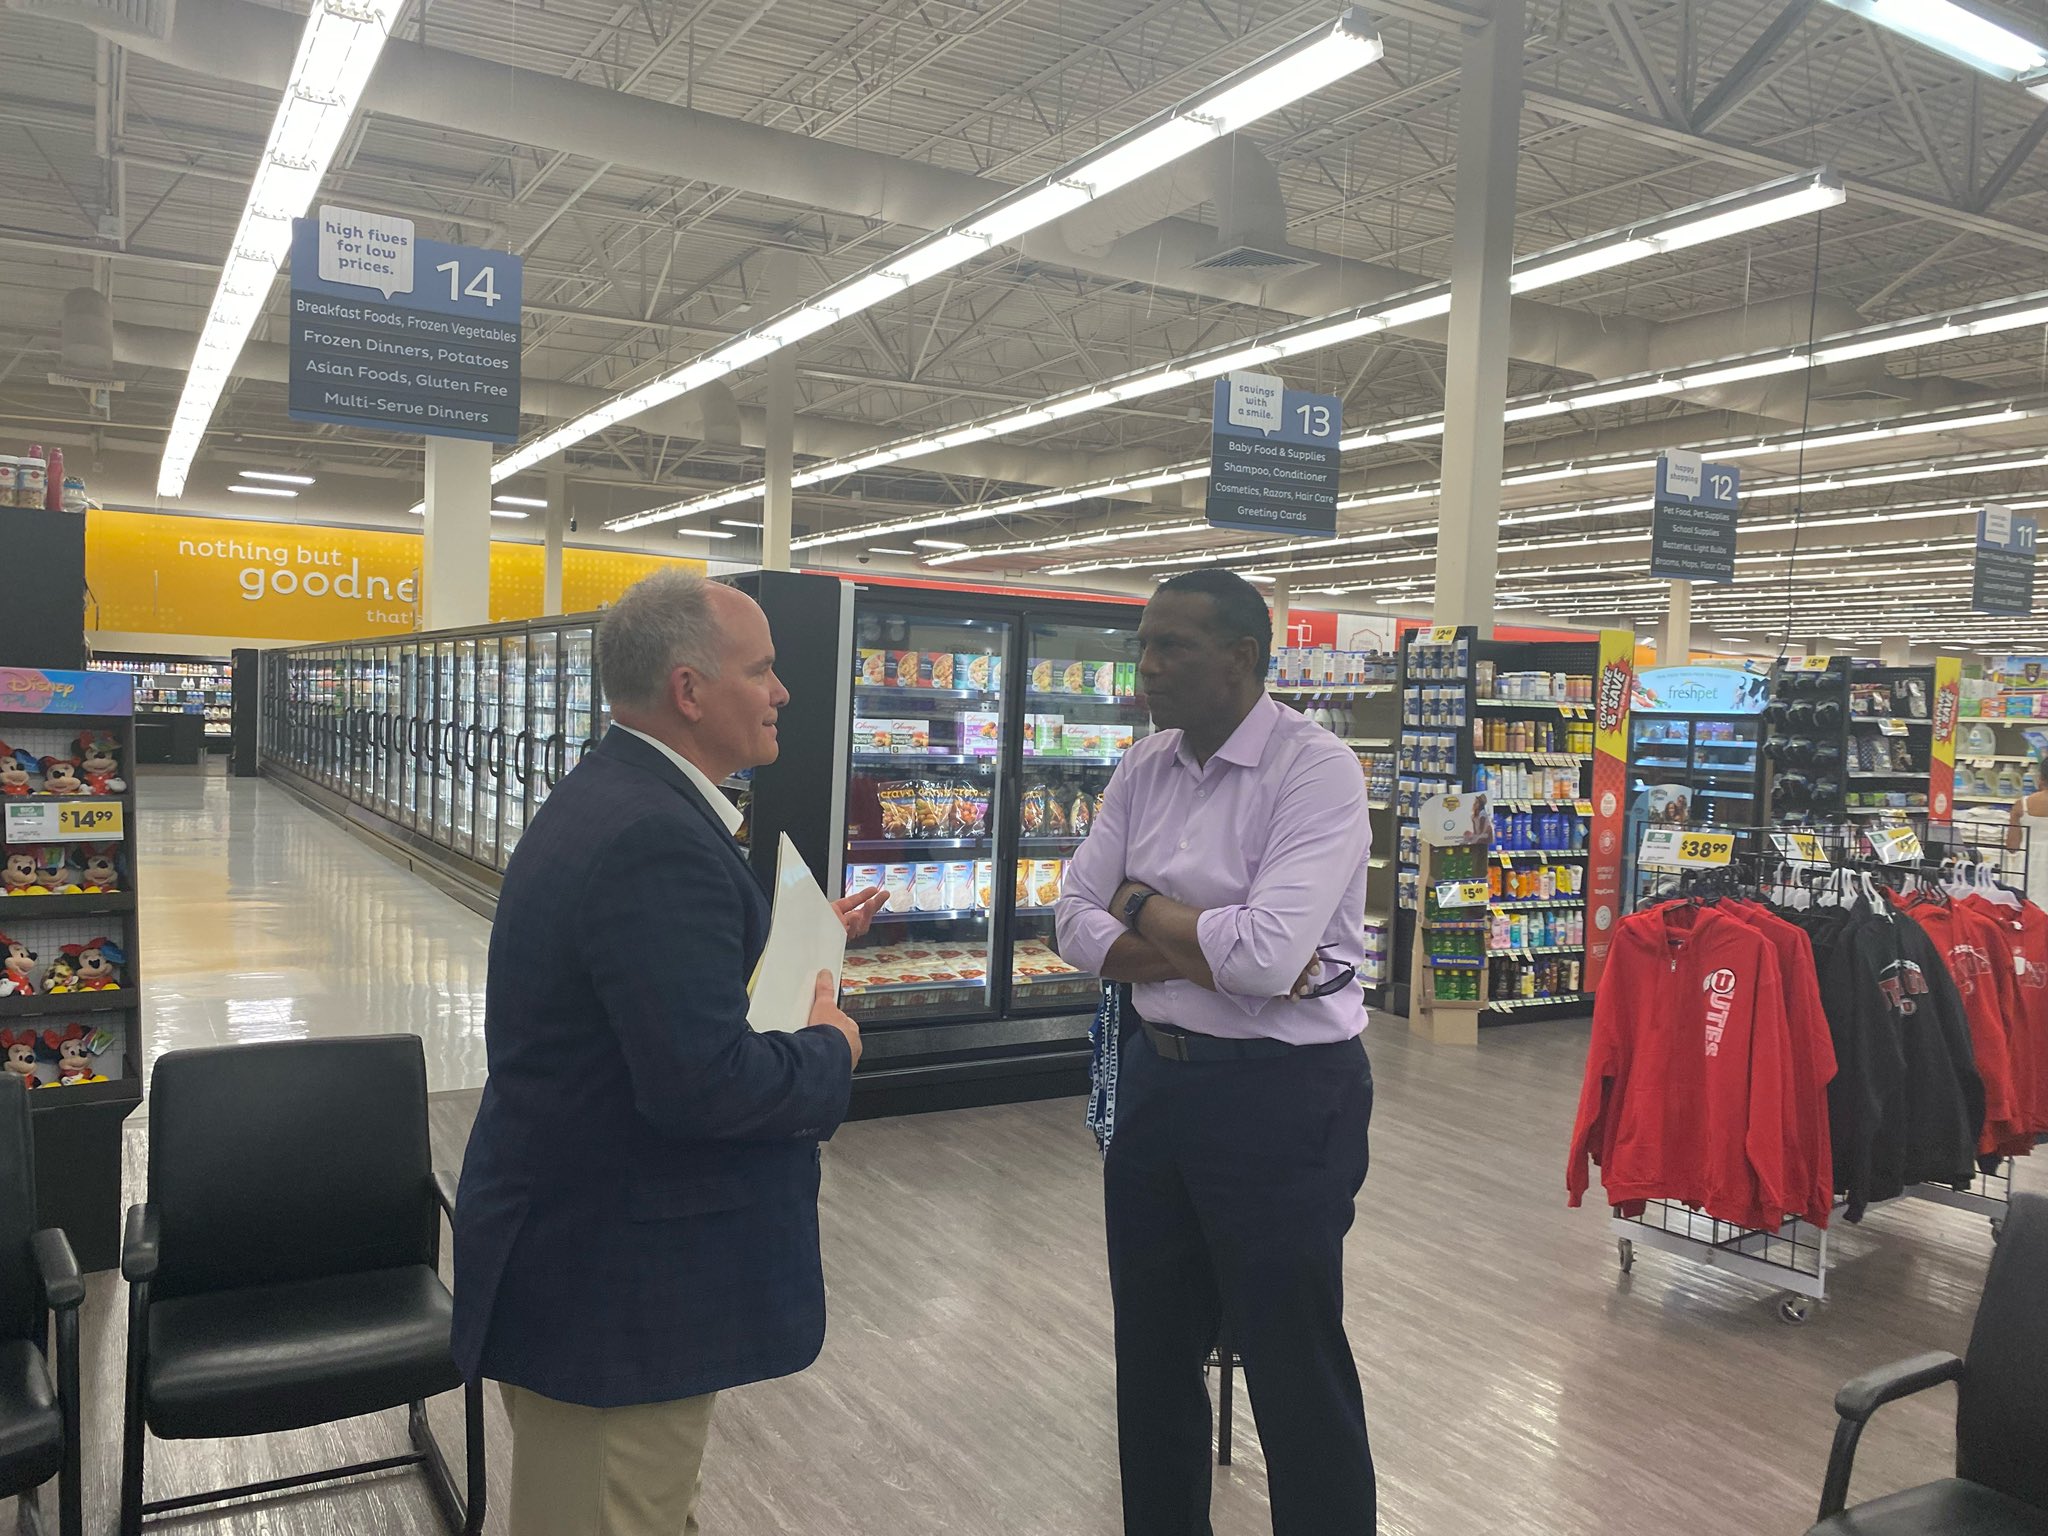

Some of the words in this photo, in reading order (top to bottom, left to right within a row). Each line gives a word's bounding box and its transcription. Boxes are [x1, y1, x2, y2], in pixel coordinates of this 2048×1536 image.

[325, 221, 363, 238] high
[368, 230, 408, 246] fives
[336, 240, 361, 254] for
[366, 244, 396, 260] low
[338, 257, 394, 275] prices.
[436, 260, 501, 307] 14
[297, 299, 361, 320] Breakfast
[364, 309, 405, 328] Foods,
[407, 316, 449, 333] Frozen
[451, 322, 517, 343] Vegetables
[304, 330, 362, 350] Frozen
[366, 338, 434, 360] Dinners,
[438, 349, 509, 370] Potatoes
[305, 360, 353, 377] Asian
[358, 366, 412, 386] Foods,
[416, 374, 470, 392] Gluten
[474, 381, 508, 397] Free
[1239, 384, 1275, 397] savings
[1245, 396, 1267, 407] with
[325, 392, 424, 415] Multi-Serve
[428, 404, 488, 423] Dinners
[1246, 408, 1274, 420] smile.
[1296, 404, 1330, 437] 13
[1229, 441, 1252, 454] Baby
[1254, 444, 1278, 456] Food
[1279, 448, 1286, 457] &
[1287, 448, 1326, 462] Supplies
[1224, 462, 1271, 477] Shampoo,
[1273, 468, 1327, 482] Conditioner
[1215, 482, 1262, 497] Cosmetics,
[1263, 488, 1294, 500] Razors,
[1295, 491, 1313, 501] Hair
[1314, 493, 1334, 504] Care
[1710, 474, 1733, 501] 12
[1238, 505, 1278, 520] Greeting
[1279, 509, 1307, 521] Cards
[1694, 526, 1720, 537] Supplies
[2017, 525, 2033, 548] 11
[179, 539, 289, 566] nothing
[297, 545, 342, 567] but
[1600, 666, 1613, 729] COMPARE
[1608, 667, 1625, 710] SAVE
[1668, 684, 1719, 702] freshpet
[1607, 714, 1617, 726] &
